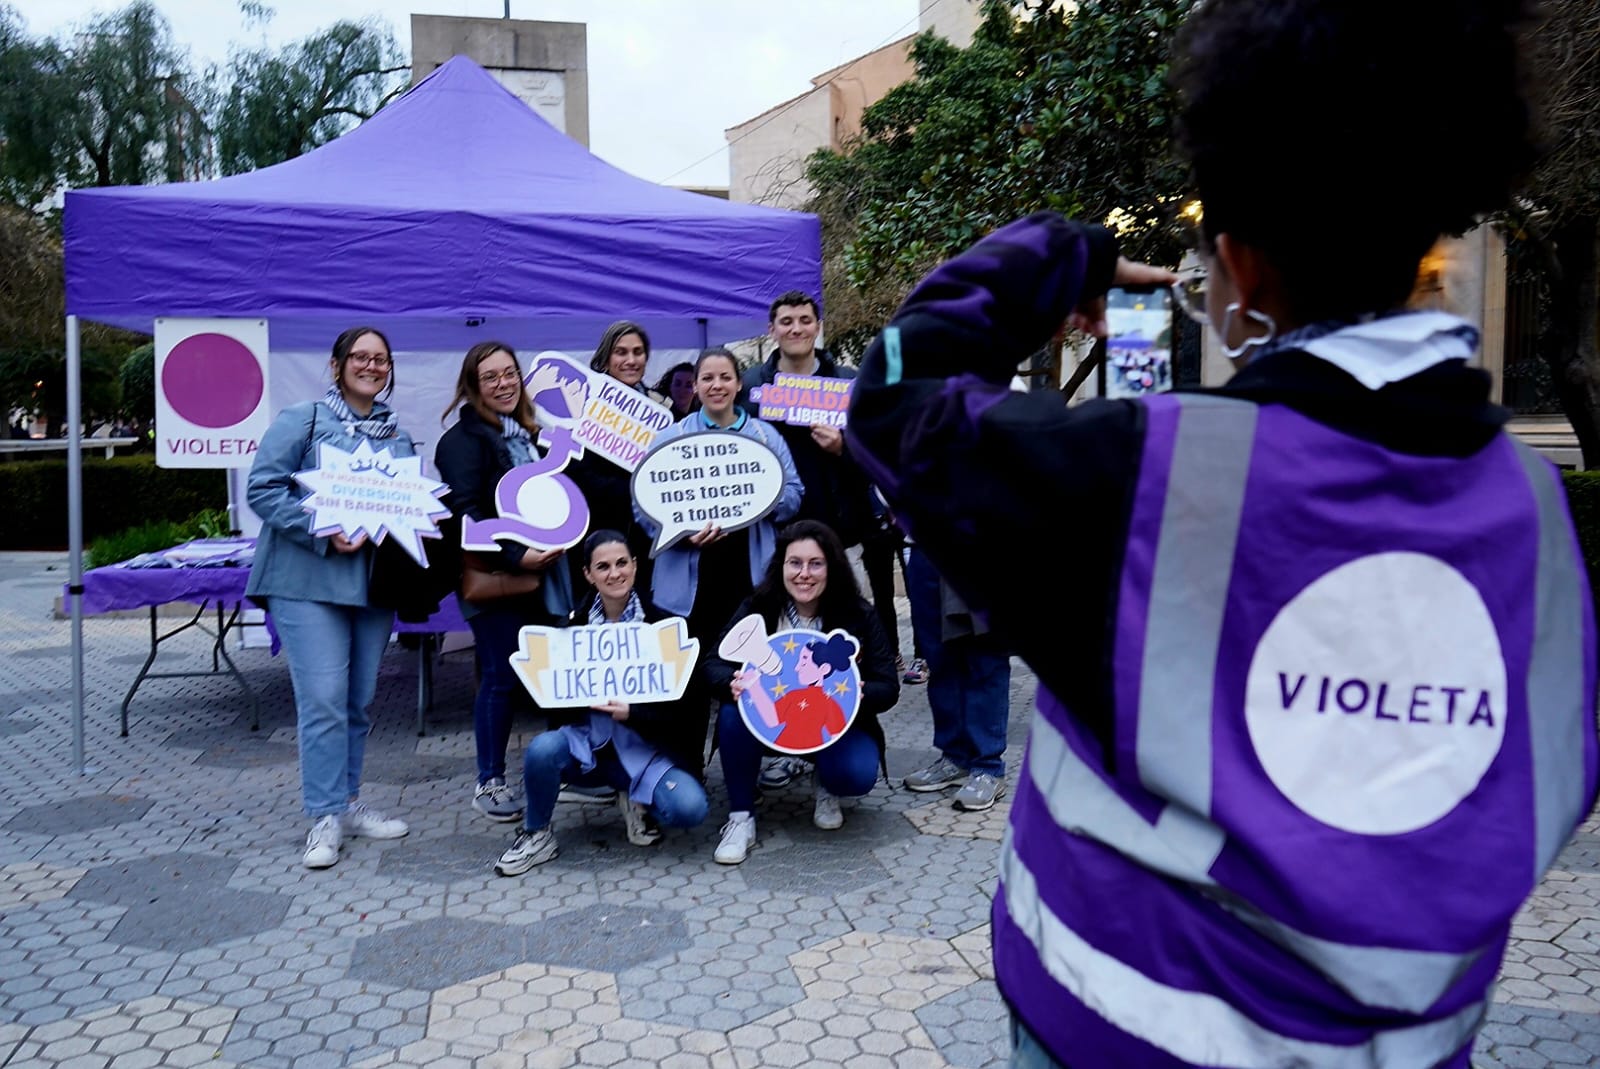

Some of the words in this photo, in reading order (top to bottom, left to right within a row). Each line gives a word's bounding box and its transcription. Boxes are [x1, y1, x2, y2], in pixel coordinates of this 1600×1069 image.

[777, 376, 821, 391] DONDE
[823, 381, 850, 393] HAY
[598, 382, 671, 431] IGUALDAD
[761, 386, 850, 411] IGUALDA
[587, 400, 656, 446] LIBERTA
[762, 407, 786, 417] HAY
[788, 407, 847, 426] LIBERTA
[167, 438, 259, 455] VIOLETA
[577, 420, 646, 466] SORORIDA
[704, 443, 738, 457] nos
[650, 467, 704, 483] tocan
[709, 465, 720, 477] a
[726, 461, 766, 475] una,
[661, 488, 696, 503] nos
[699, 482, 755, 499] tocan
[316, 496, 340, 507] SIN
[344, 498, 424, 517] BARRERAS
[672, 511, 684, 523] a
[572, 627, 641, 662] FIGHT
[554, 667, 597, 699] LIKE
[604, 667, 618, 696] A
[622, 662, 670, 696] GIRL
[1278, 672, 1494, 727] VIOLETA
